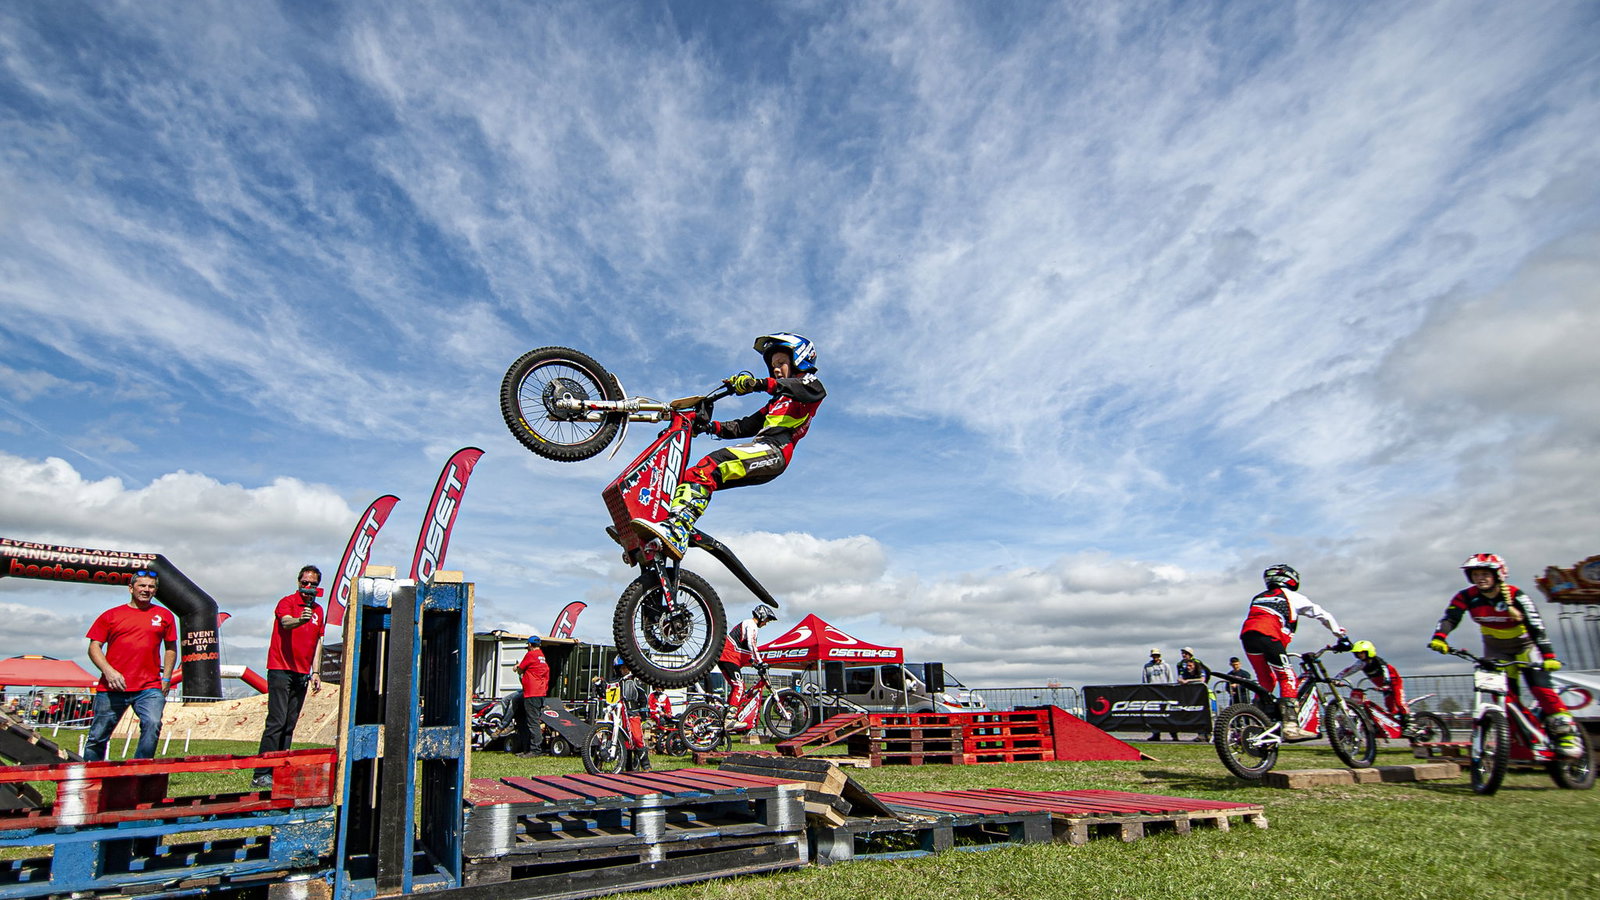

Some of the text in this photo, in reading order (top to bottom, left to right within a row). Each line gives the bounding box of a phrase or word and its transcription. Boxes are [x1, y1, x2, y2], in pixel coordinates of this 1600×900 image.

[749, 456, 780, 470] OSET
[650, 499, 660, 520] TEAM
[416, 463, 462, 584] OSET
[1, 538, 157, 560] EVENT INFLATABLES
[3, 547, 151, 569] MANUFACTURED BY
[336, 507, 381, 608] OSET
[187, 630, 215, 639] EVENT
[828, 648, 897, 658] OSETBIKES
[608, 688, 617, 703] 7
